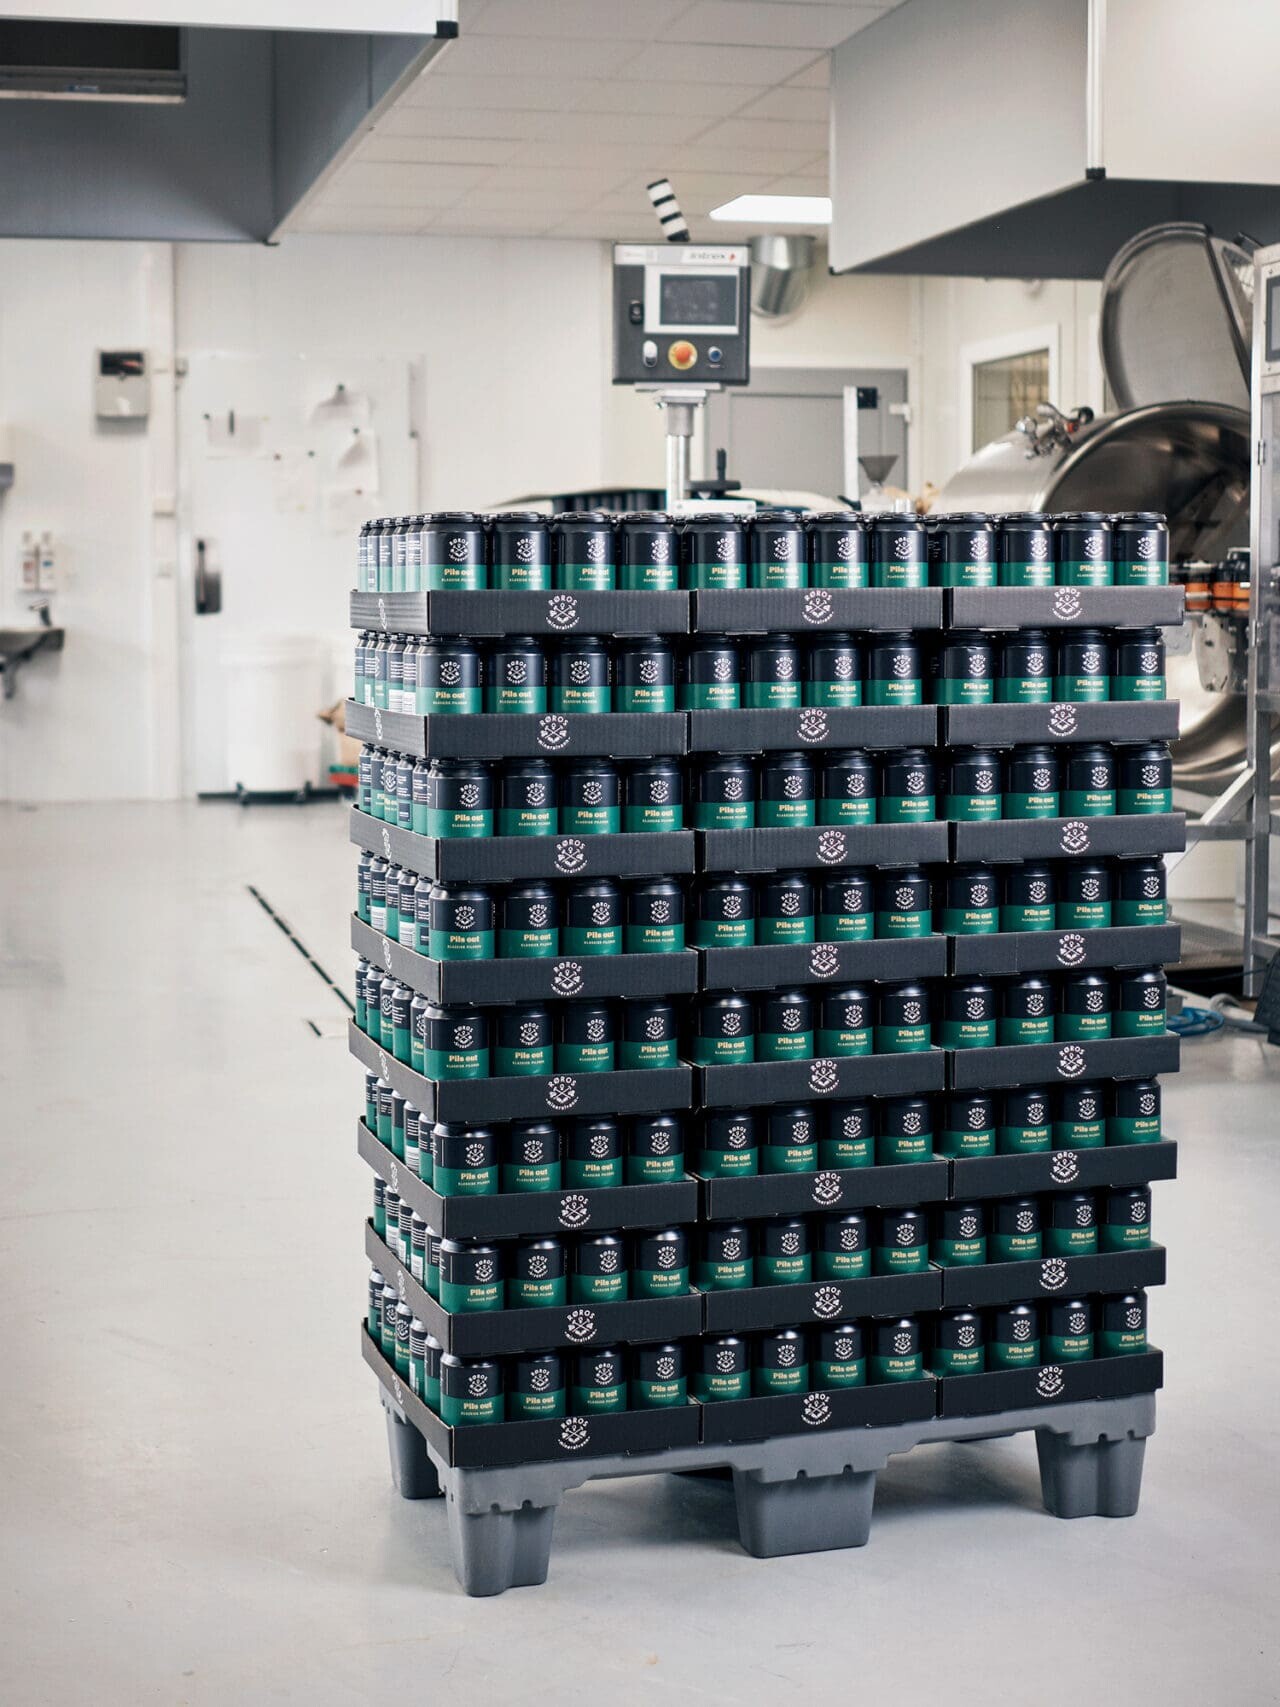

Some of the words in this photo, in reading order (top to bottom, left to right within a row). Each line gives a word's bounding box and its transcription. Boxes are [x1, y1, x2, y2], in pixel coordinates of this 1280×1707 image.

[804, 590, 832, 601] RØROS
[1054, 587, 1081, 598] RØROS
[548, 595, 577, 606] RØROS
[800, 709, 827, 720] RØROS
[1050, 704, 1076, 714] RØROS
[539, 715, 568, 726] RØROS
[1063, 822, 1089, 832] RØROS
[818, 831, 846, 841] RØROS
[557, 839, 585, 850] RØROS
[1059, 934, 1085, 944] RØROS
[811, 944, 838, 955] RØROS
[554, 962, 582, 973] RØROS
[1059, 1046, 1085, 1056] RØROS
[810, 1060, 837, 1071] RØROS
[548, 1076, 576, 1088] RØROS
[1052, 1152, 1077, 1162] RØROS
[815, 1173, 841, 1184] RØROS
[561, 1195, 588, 1206] RØROS
[1042, 1258, 1067, 1270] RØROS
[815, 1286, 841, 1298] RØROS
[567, 1309, 595, 1321] RØROS
[1038, 1366, 1063, 1377] RØROS
[804, 1393, 830, 1405] RØROS
[561, 1417, 588, 1429] RØROS
